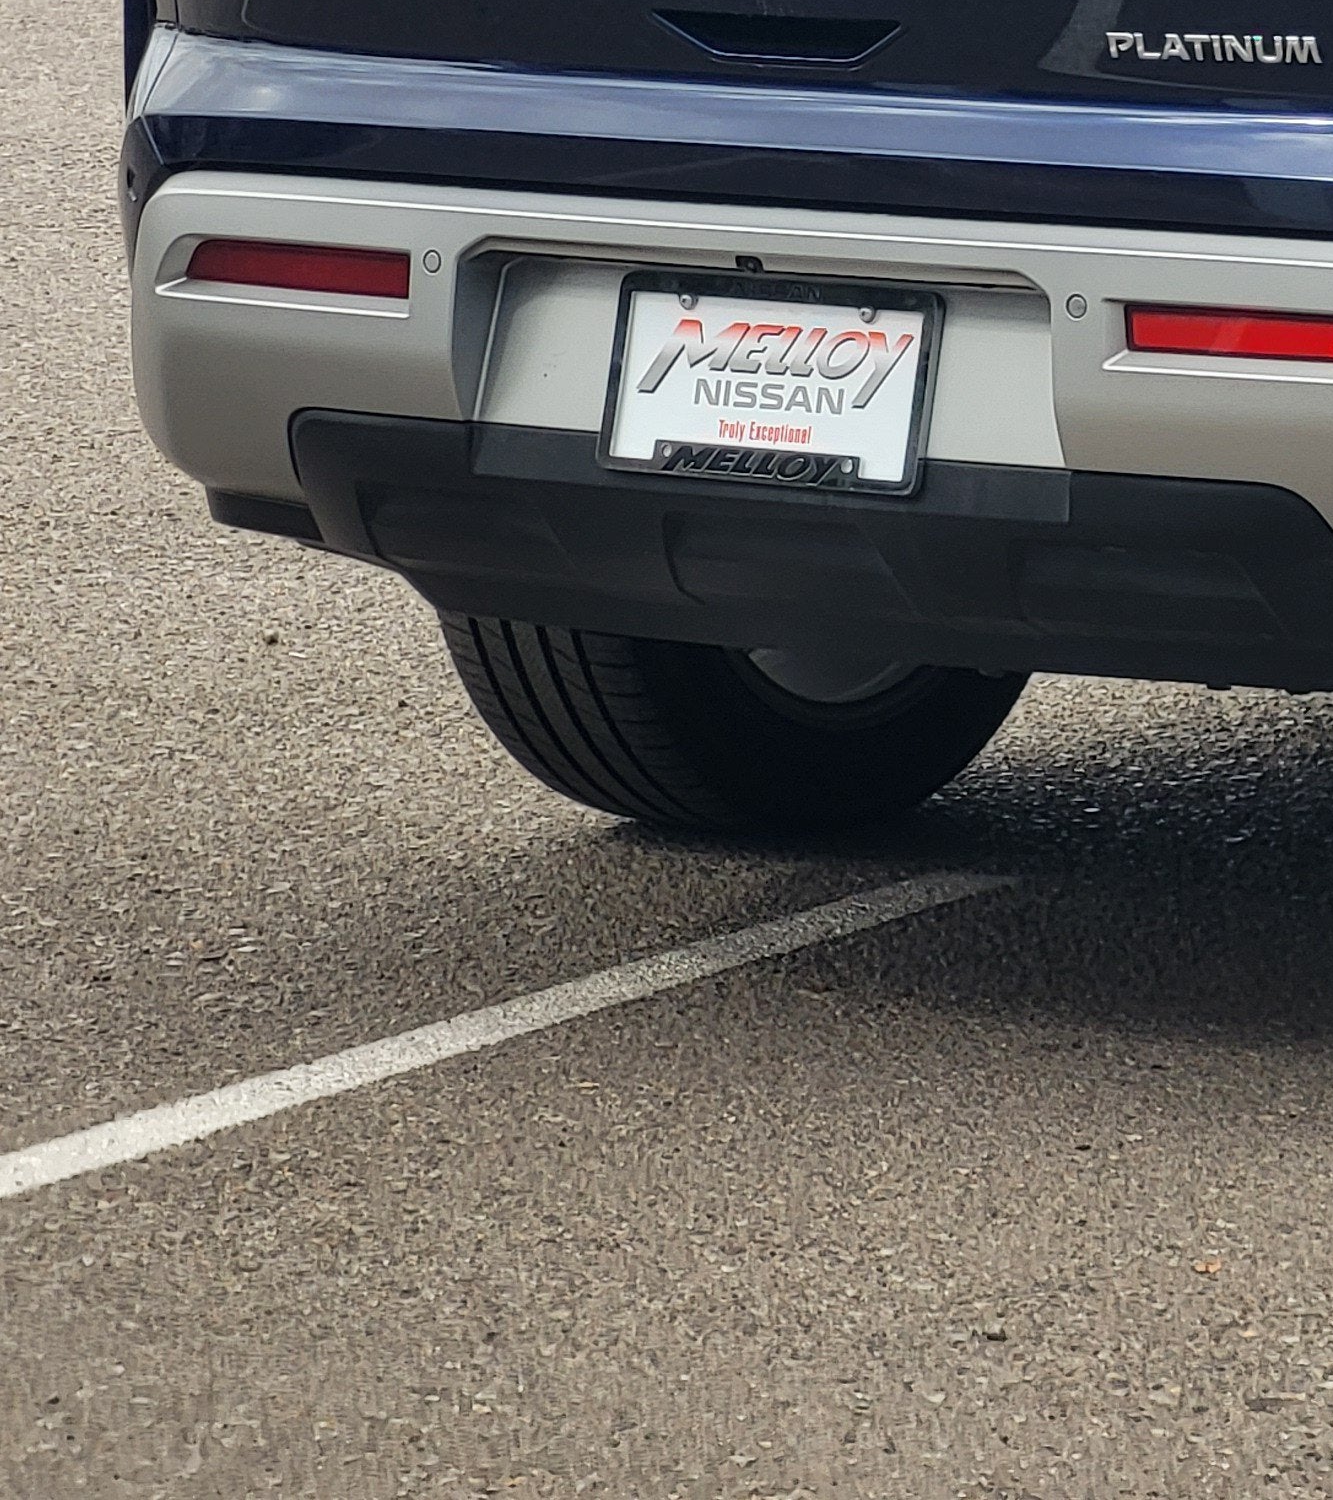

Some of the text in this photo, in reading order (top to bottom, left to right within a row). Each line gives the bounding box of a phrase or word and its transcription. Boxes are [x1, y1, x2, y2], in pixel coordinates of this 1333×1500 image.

[1105, 32, 1323, 64] PLATINUM
[637, 319, 915, 409] MELLOY
[694, 378, 846, 415] NISSAN
[719, 420, 812, 445] Truly Exceptional
[662, 444, 842, 486] MELLOY
